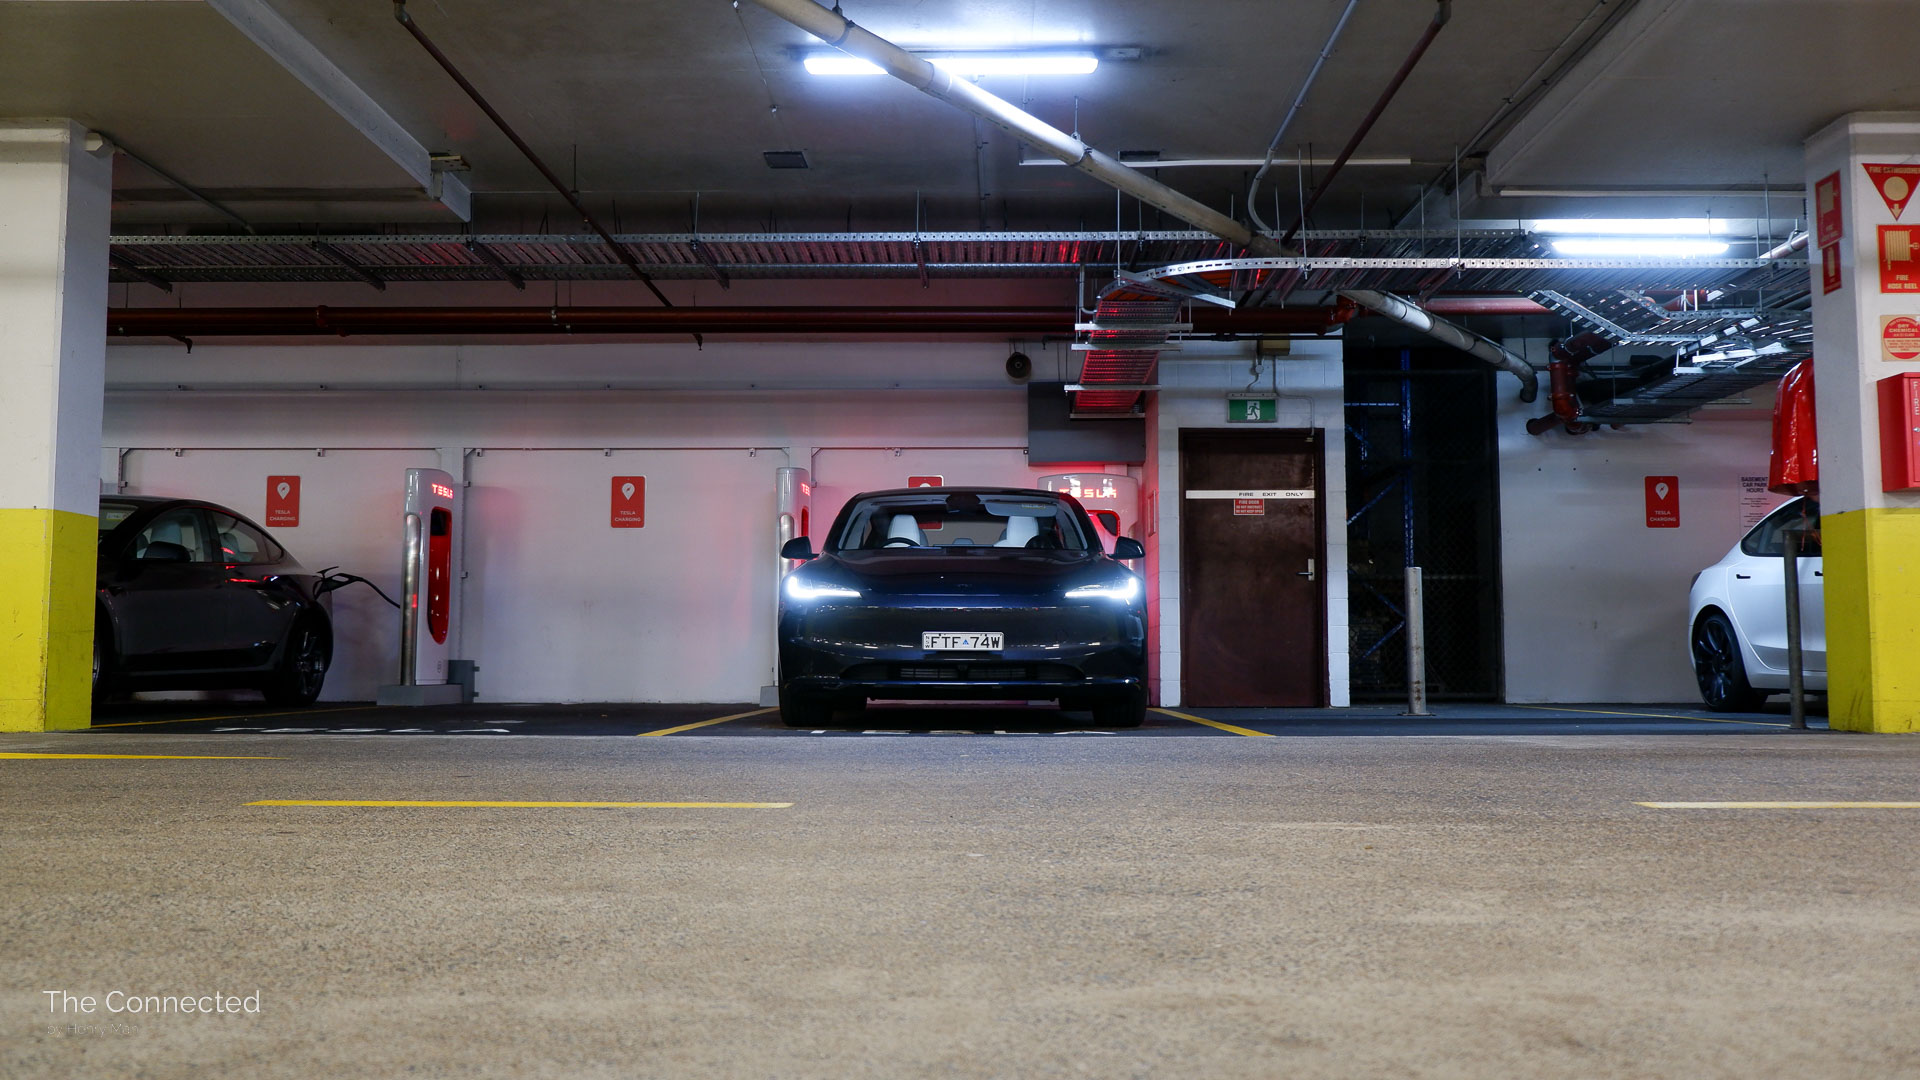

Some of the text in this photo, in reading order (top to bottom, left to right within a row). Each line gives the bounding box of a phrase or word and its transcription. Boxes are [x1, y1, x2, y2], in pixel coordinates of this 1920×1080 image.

[1912, 381, 1920, 416] FIRE
[431, 482, 454, 499] TESLA
[1058, 488, 1118, 499] TESLA
[930, 636, 1000, 649] FTF 74W
